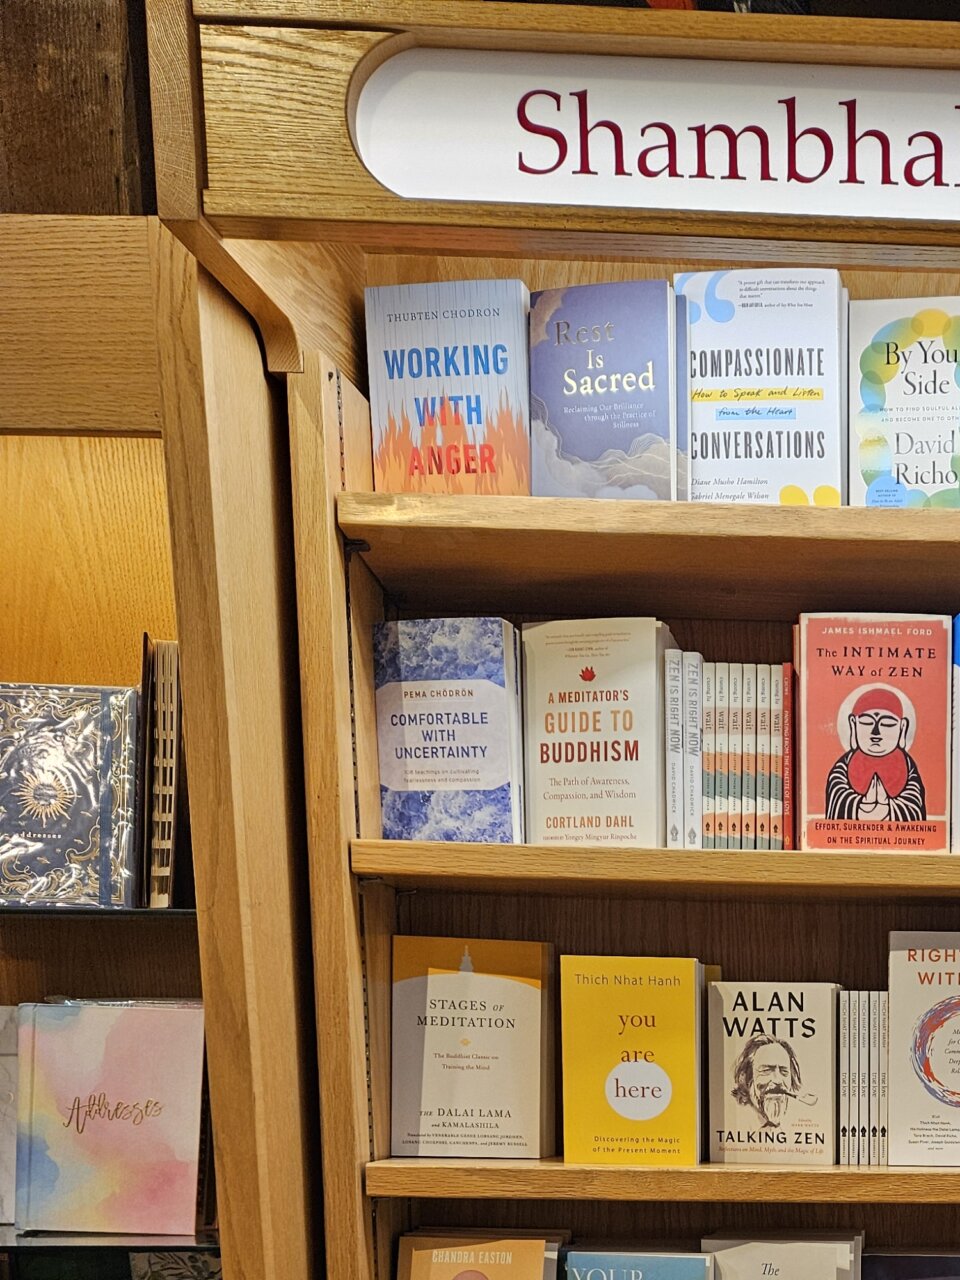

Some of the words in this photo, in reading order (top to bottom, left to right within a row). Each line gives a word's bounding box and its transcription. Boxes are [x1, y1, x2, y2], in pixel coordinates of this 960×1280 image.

[387, 311, 439, 323] THUBTEN
[442, 307, 500, 319] CHODRON
[383, 344, 508, 379] WORKING
[691, 348, 824, 378] COMPASSIONATE
[885, 342, 912, 375] By
[563, 363, 655, 395] Sacred
[904, 371, 949, 395] Side
[414, 394, 481, 427] WITH
[691, 431, 825, 460] CONVERSATIONS
[895, 431, 955, 455] David
[408, 443, 496, 476] ANGER
[895, 463, 958, 485] Richo
[822, 627, 855, 635] JAMES
[858, 627, 902, 636] ISHMAEL
[907, 628, 932, 636] FORD
[817, 648, 837, 658] The
[843, 646, 937, 659] INTIMATE
[832, 665, 865, 677] WAY
[871, 668, 881, 677] of
[889, 666, 923, 677] ZEN
[390, 712, 488, 726] COMFORTABLE
[422, 730, 456, 742] WITH
[395, 746, 488, 759] UNCERTAINTY
[540, 740, 639, 764] BUDDHISM
[430, 999, 487, 1011] STAGES
[732, 991, 804, 1012] ALAN
[417, 1016, 516, 1028] MEDITATION
[619, 1015, 656, 1035] you
[723, 1017, 816, 1038] WATTS
[614, 1078, 662, 1098] here
[63, 1092, 163, 1134] Addresses
